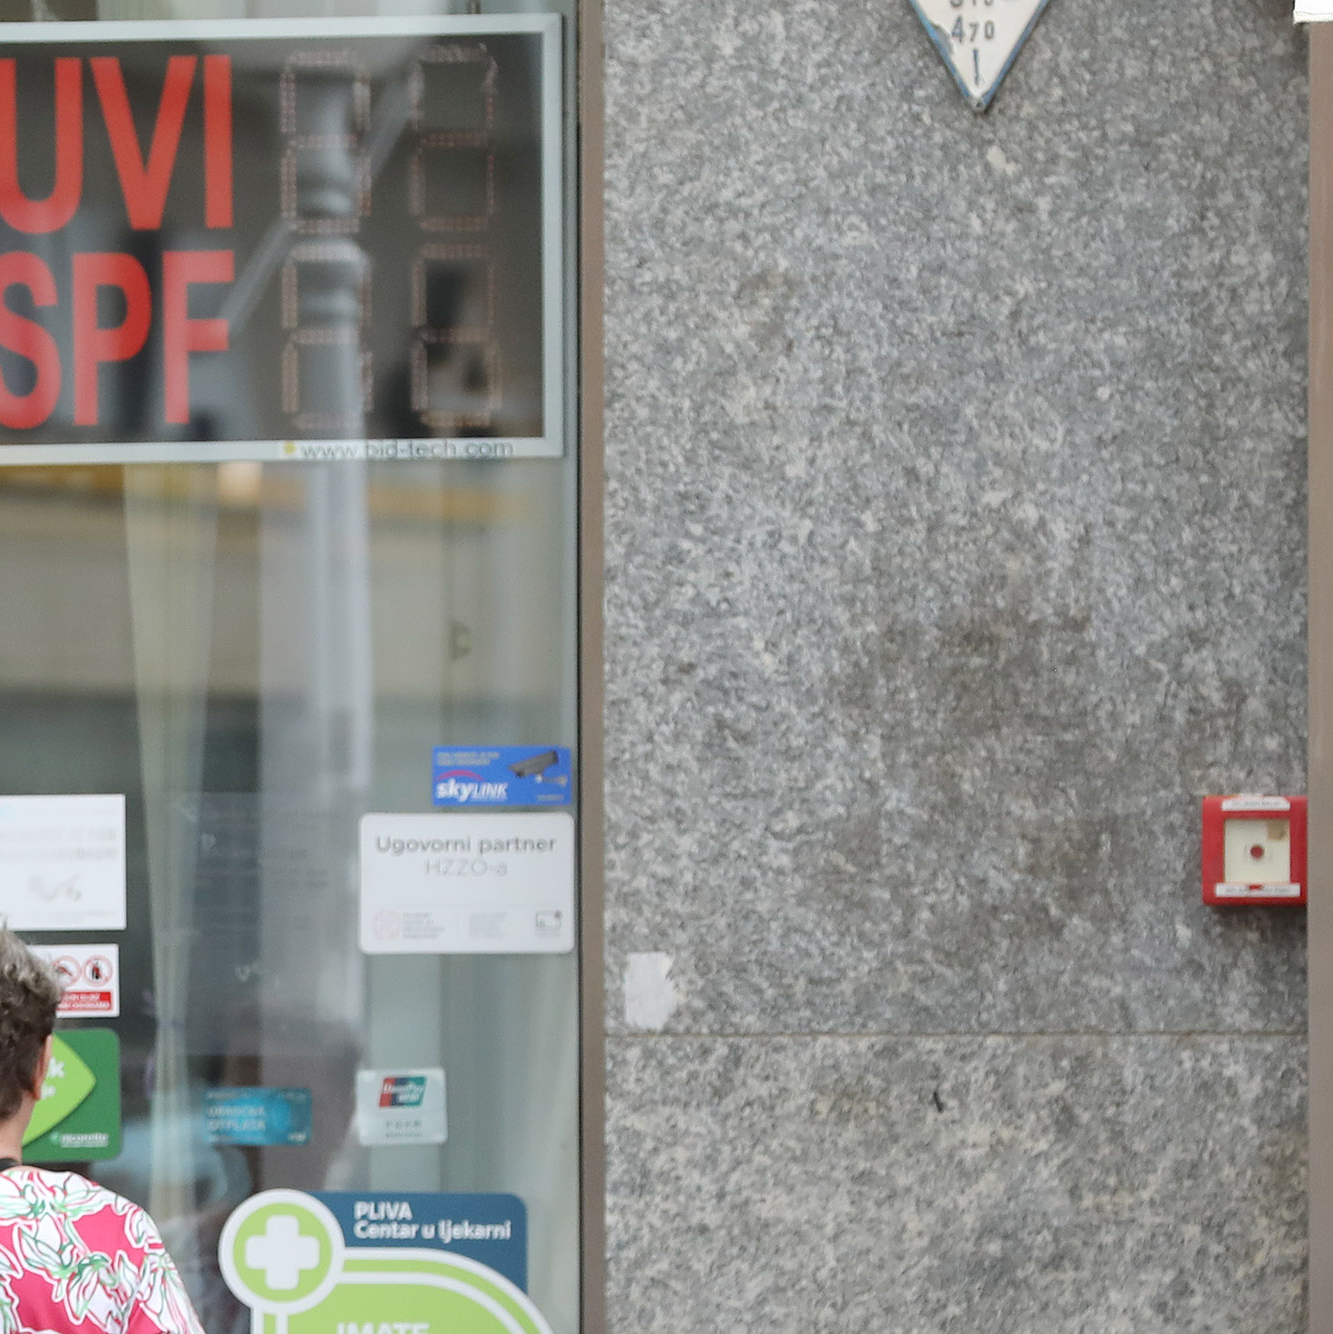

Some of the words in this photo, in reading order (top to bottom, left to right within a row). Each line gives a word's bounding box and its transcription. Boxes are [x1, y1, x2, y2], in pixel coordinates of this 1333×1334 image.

[374, 835, 472, 857] Ugovorni
[478, 836, 557, 855] partner
[354, 1201, 412, 1221] PLIVA
[353, 1221, 415, 1239] Centar
[422, 1226, 434, 1239] u
